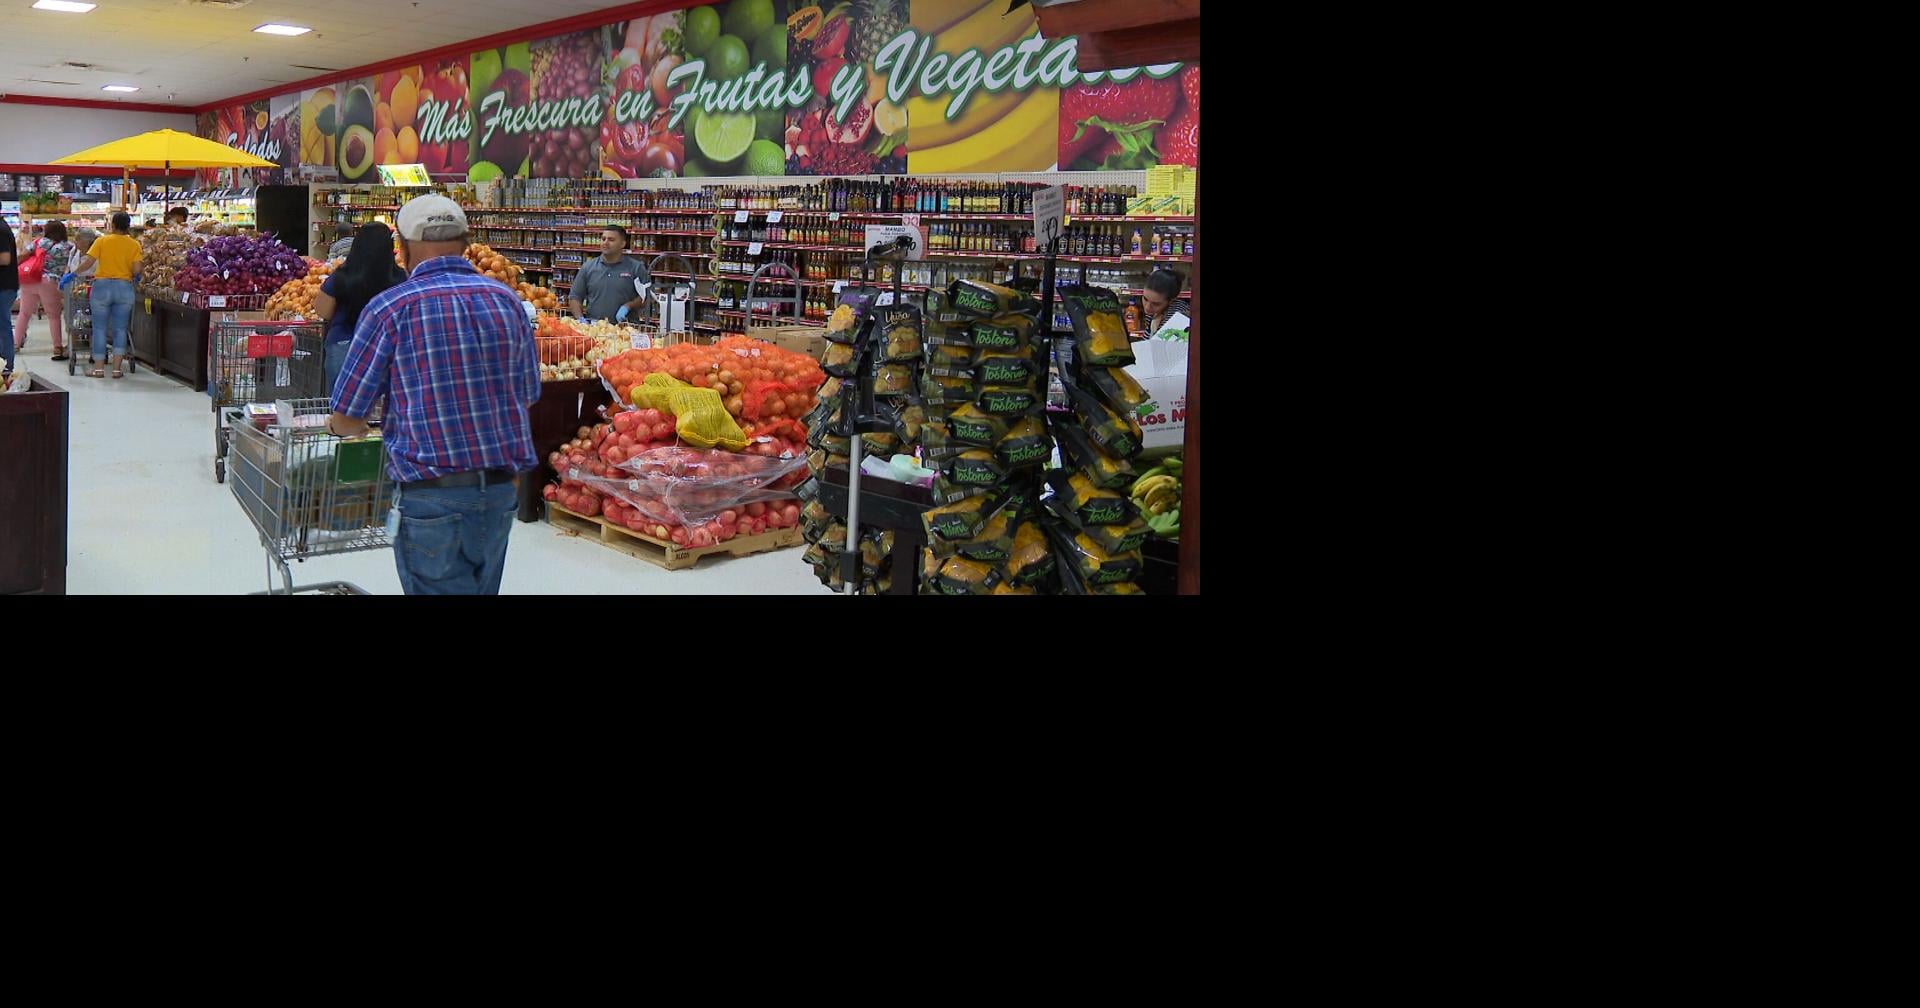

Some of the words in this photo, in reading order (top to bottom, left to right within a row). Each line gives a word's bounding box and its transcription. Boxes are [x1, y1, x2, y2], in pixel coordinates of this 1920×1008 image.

[417, 98, 471, 144] Más
[480, 90, 602, 148] Frescura
[615, 89, 652, 123] en
[666, 59, 813, 129] Frutas
[830, 63, 866, 124] y
[874, 29, 1183, 120] Vegeta
[1137, 413, 1167, 426] LOS
